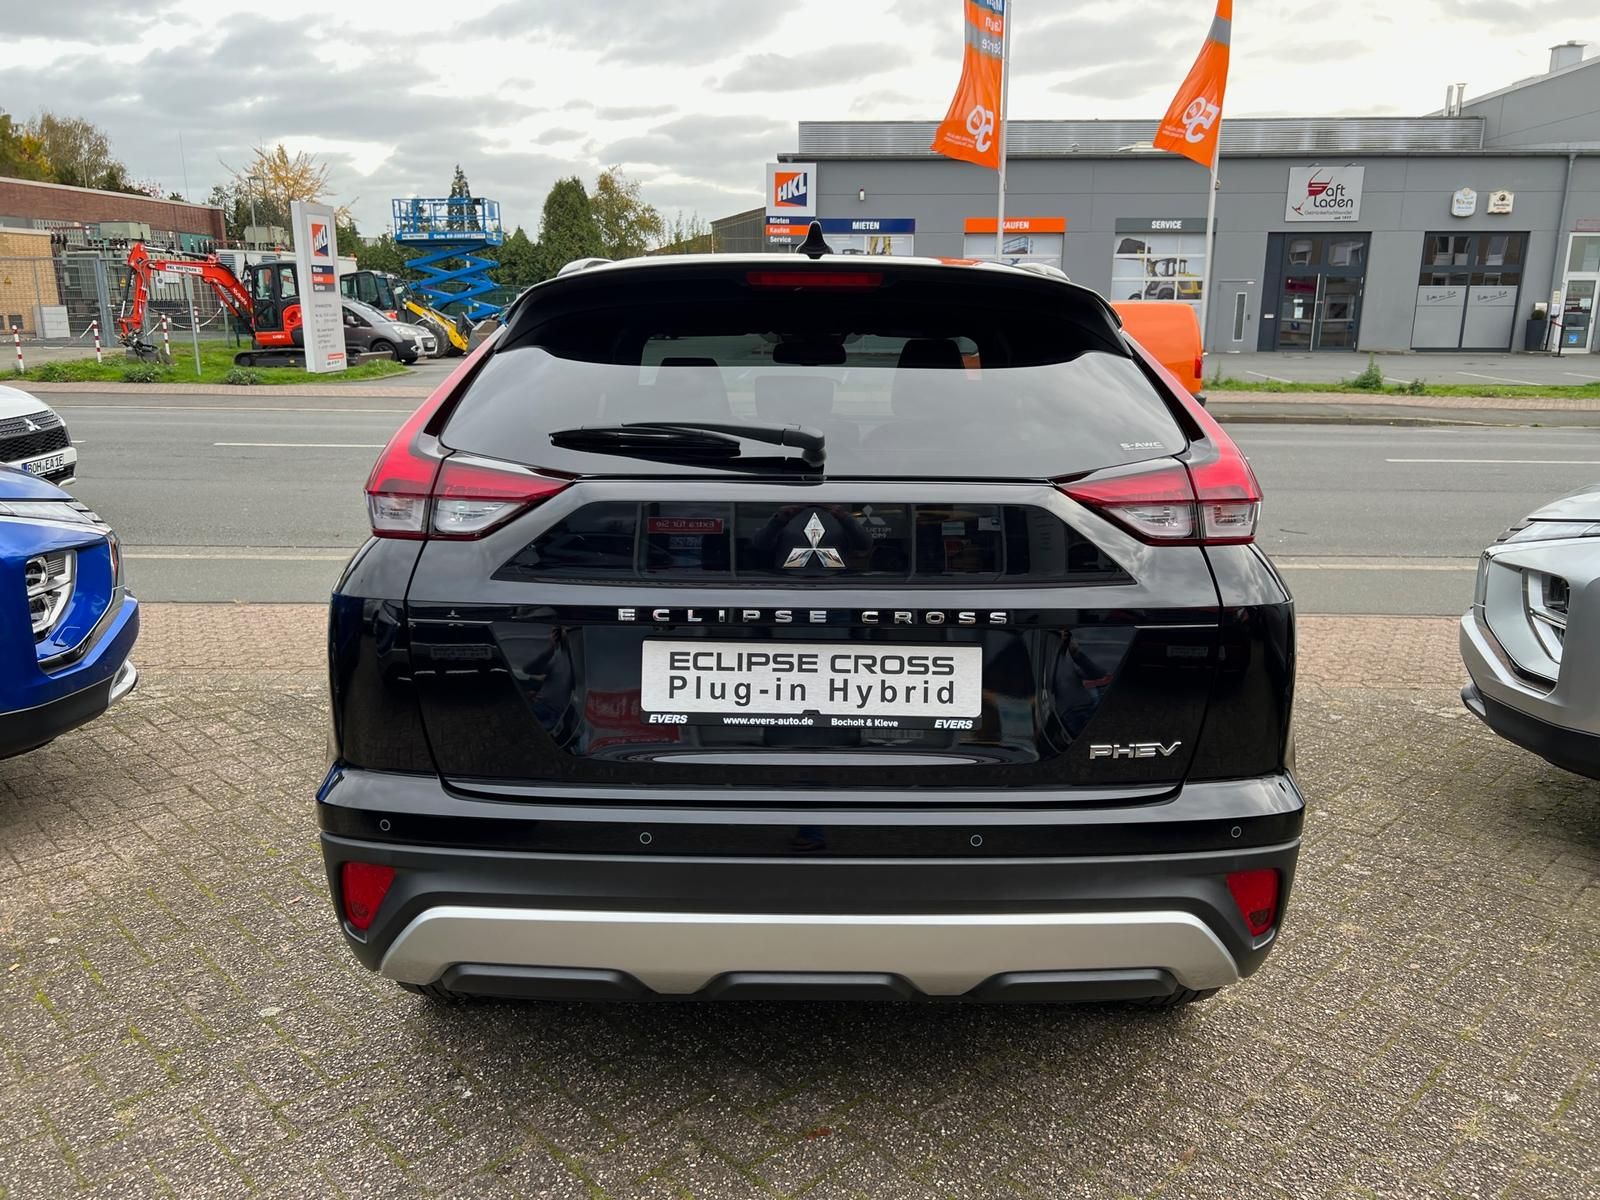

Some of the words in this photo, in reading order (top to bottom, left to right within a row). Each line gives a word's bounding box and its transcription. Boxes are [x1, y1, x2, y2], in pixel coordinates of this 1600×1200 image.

[777, 173, 807, 202] HKL
[1313, 195, 1353, 208] Laden
[852, 220, 880, 231] MIETEN
[1151, 220, 1182, 230] SERVICE
[313, 225, 329, 252] HKL
[617, 608, 828, 624] ECLIPSE
[860, 609, 1009, 625] CROSS
[669, 651, 819, 674] ECLIPSE
[830, 653, 954, 676] CROSS
[669, 675, 807, 706] Plug-in
[828, 677, 954, 708] Hybrid
[649, 714, 688, 724] EVERS
[722, 715, 814, 726] www.evers-auto.de
[831, 717, 865, 727] Bocholt
[866, 719, 872, 727] &
[874, 719, 899, 728] Kleve
[934, 719, 973, 729] EVERS
[1089, 741, 1182, 760] PHEV
